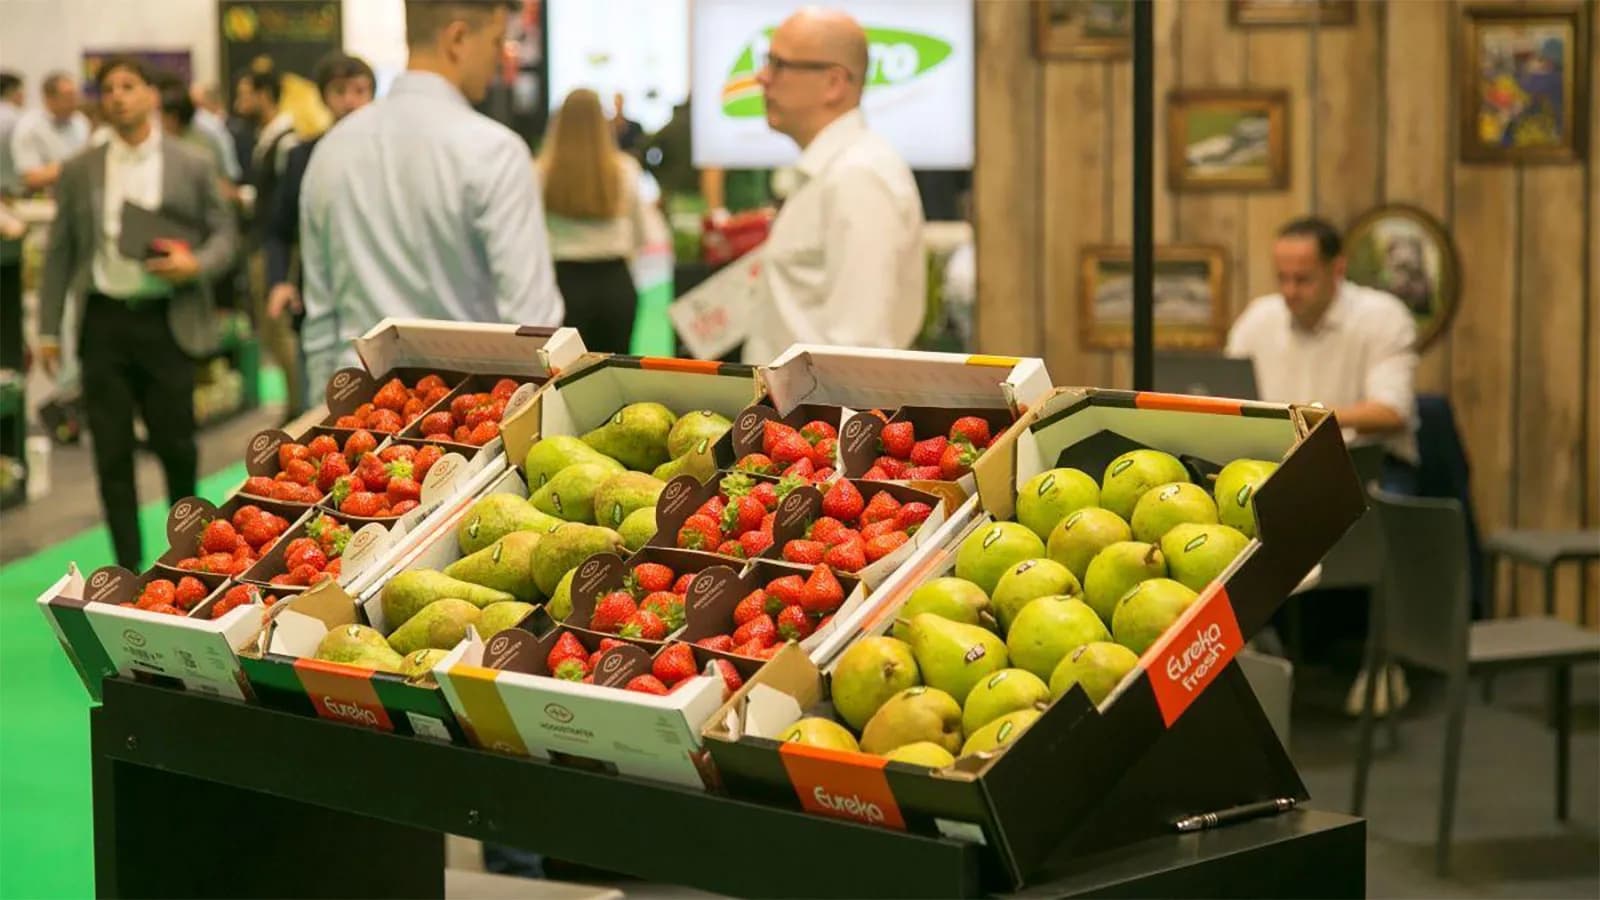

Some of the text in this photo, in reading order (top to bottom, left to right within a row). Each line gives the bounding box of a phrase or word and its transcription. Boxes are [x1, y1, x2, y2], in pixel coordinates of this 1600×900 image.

[1166, 623, 1221, 680] Eureka
[324, 695, 378, 725] Eureka
[813, 786, 884, 822] Eureka
